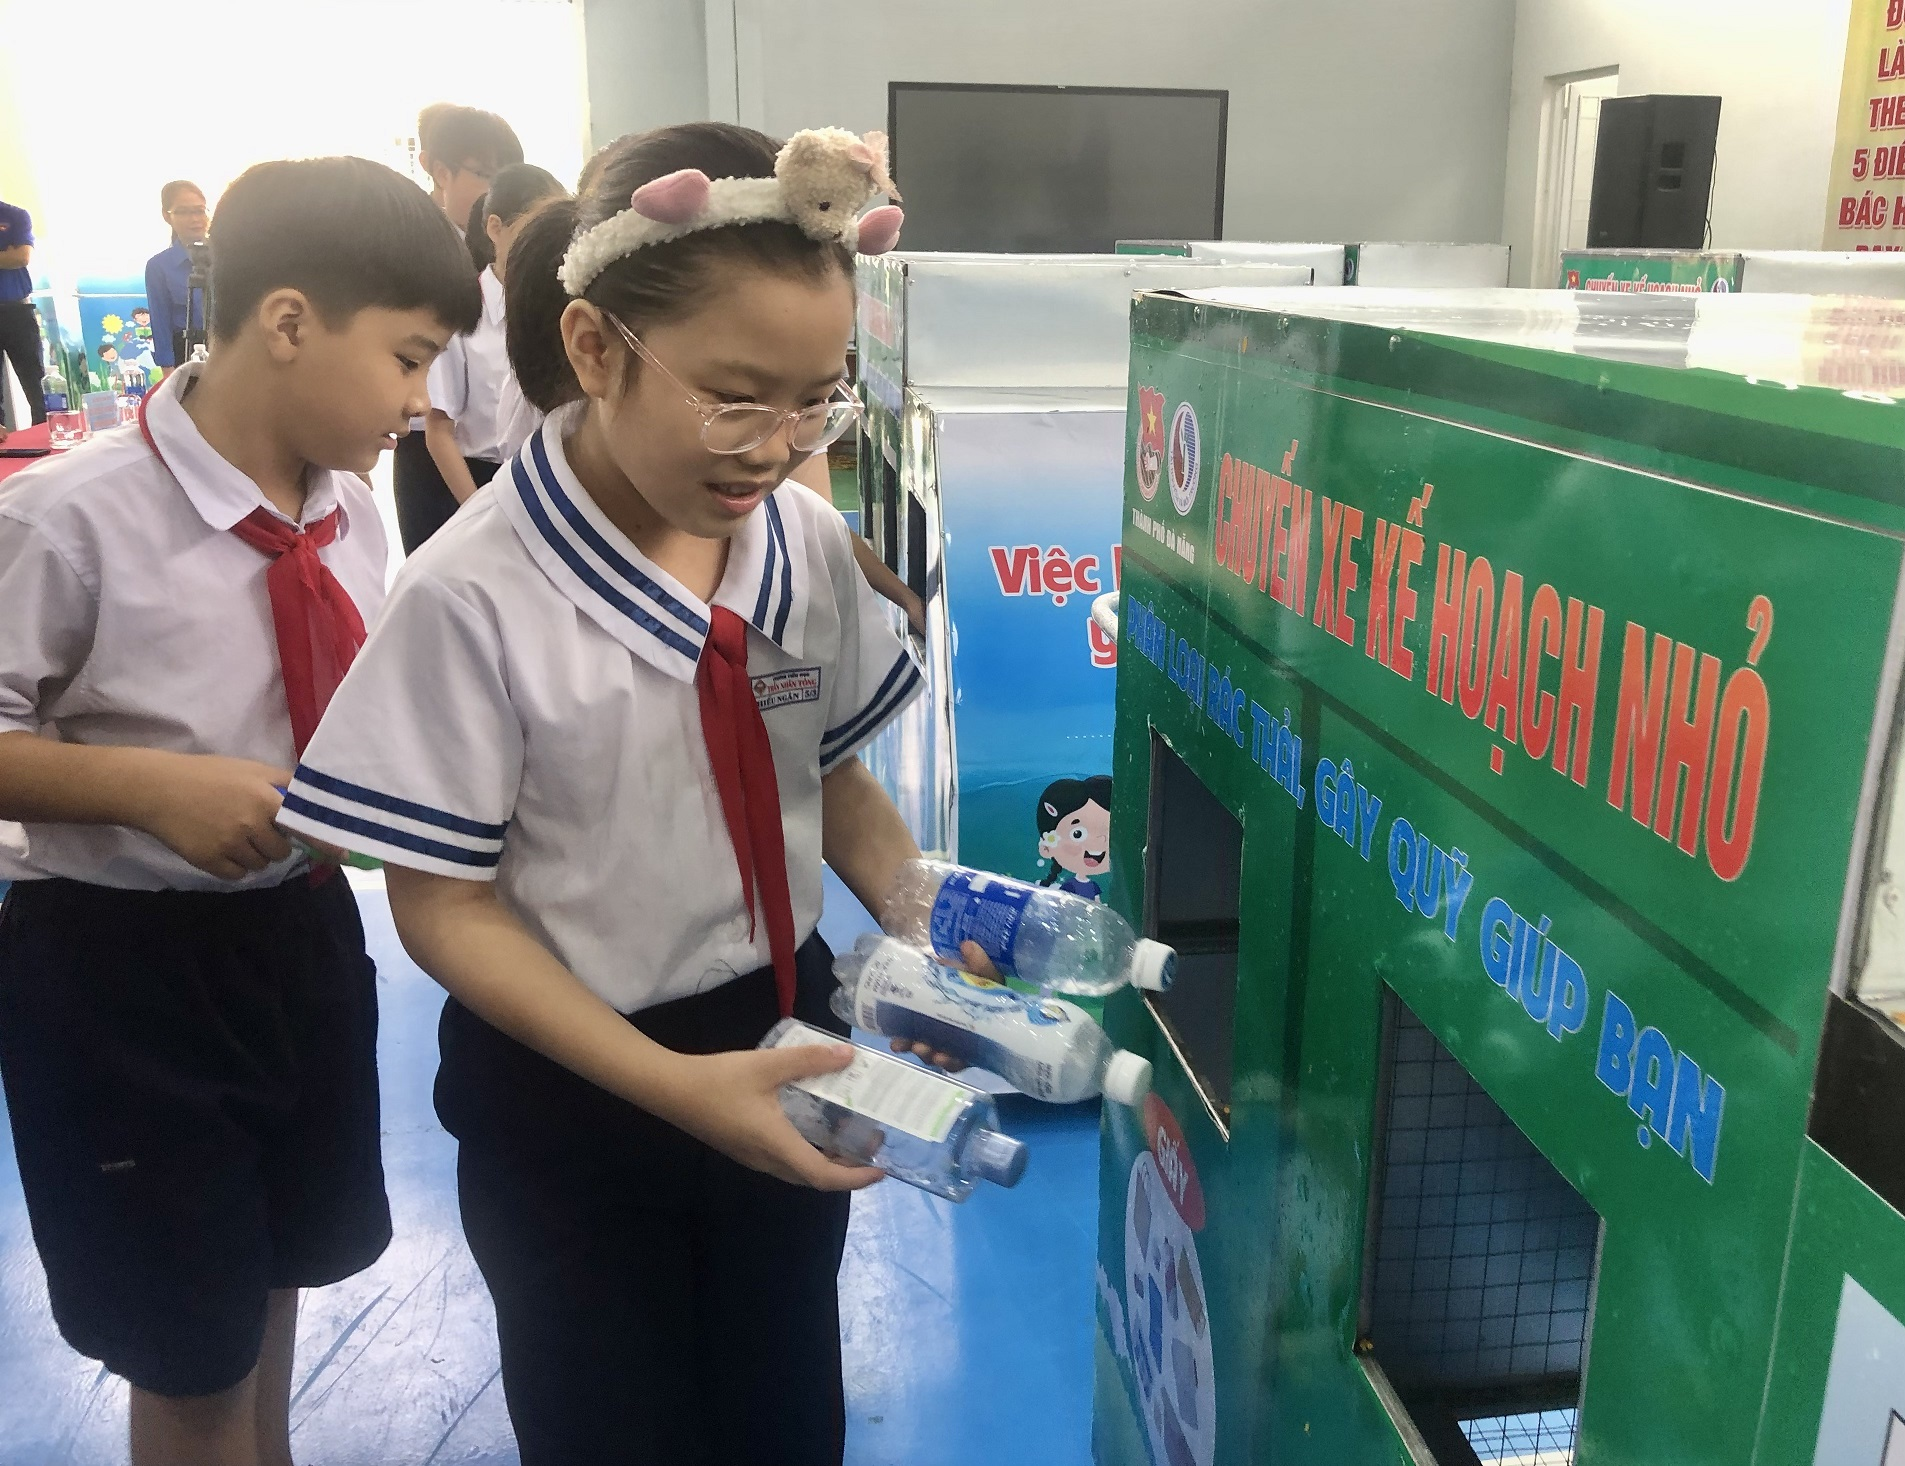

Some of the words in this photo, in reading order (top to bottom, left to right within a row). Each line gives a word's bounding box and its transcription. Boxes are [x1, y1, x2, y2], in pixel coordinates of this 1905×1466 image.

[1886, 0, 1905, 31] Đ
[1852, 147, 1869, 180] 5
[1838, 190, 1887, 229] BÁC
[1132, 507, 1152, 536] THÀNH
[1152, 519, 1166, 544] PHỐ
[989, 545, 1100, 606] Việc
[1215, 439, 1313, 617] CHUYẾN
[1313, 496, 1364, 647] XE
[1365, 484, 1434, 681] KẾ
[1426, 542, 1606, 788] HOẠCH
[1606, 594, 1774, 881] NHỎ
[1126, 594, 1167, 672] PHÂN
[1167, 629, 1206, 712] LOẠI
[1206, 665, 1246, 748] RÁC
[1251, 700, 1306, 810] THẢI,
[1314, 757, 1383, 862] GÂY
[1387, 817, 1474, 943] QUỸ
[1480, 896, 1589, 1043] GIÚP
[1595, 989, 1726, 1186] BẠN
